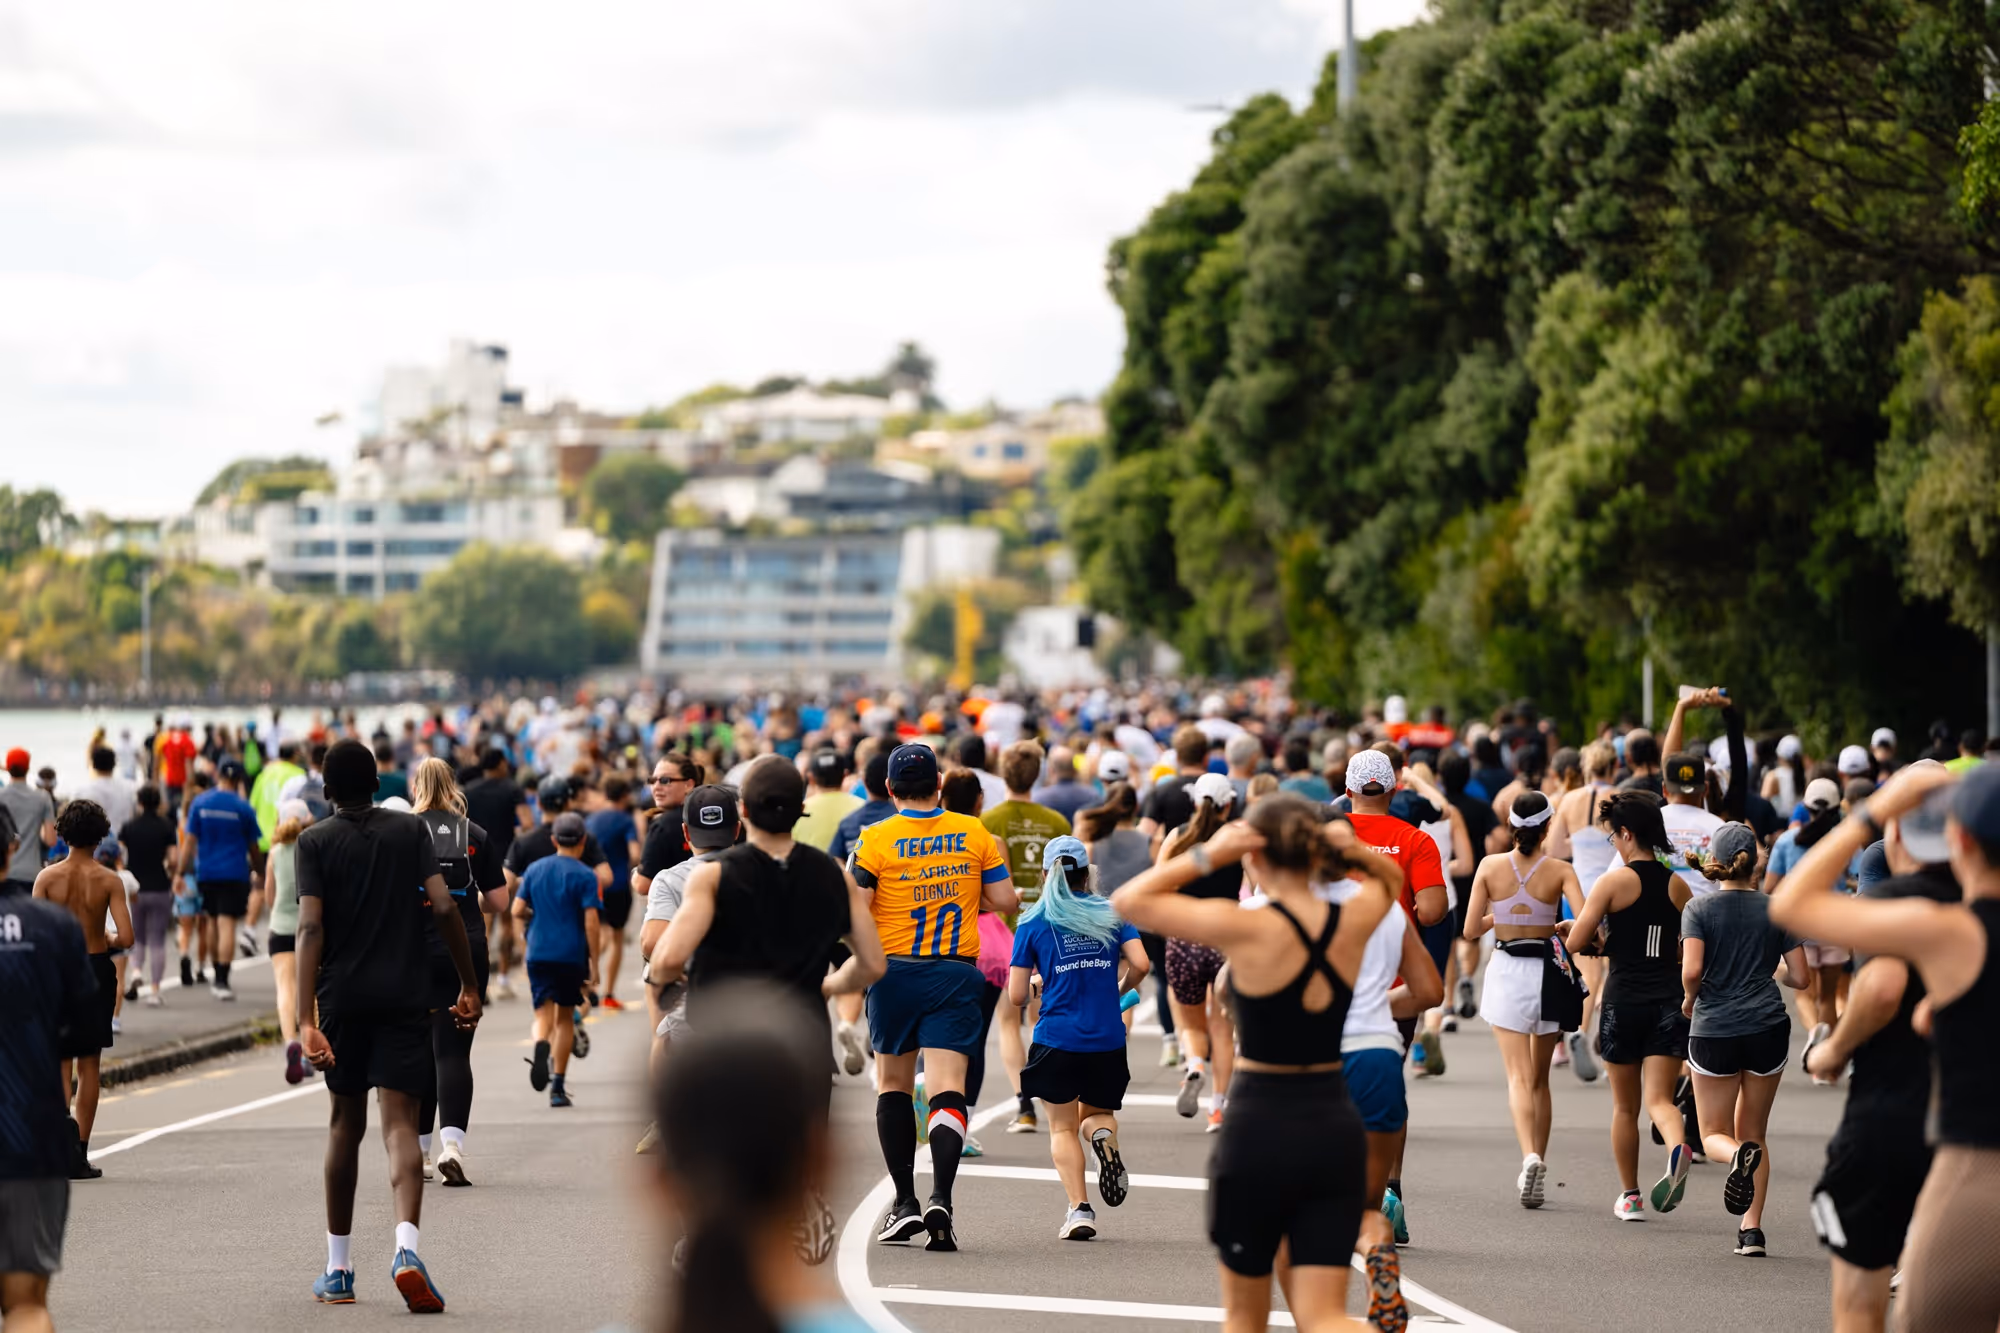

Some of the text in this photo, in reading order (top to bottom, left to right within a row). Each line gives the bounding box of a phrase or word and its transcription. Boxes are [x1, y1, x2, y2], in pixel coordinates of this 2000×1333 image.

[893, 833, 968, 859] TECATE
[918, 862, 972, 880] AFIRME
[914, 881, 959, 902] GIGNAC
[910, 902, 962, 956] 10
[1055, 959, 1111, 974] Round the Bays
